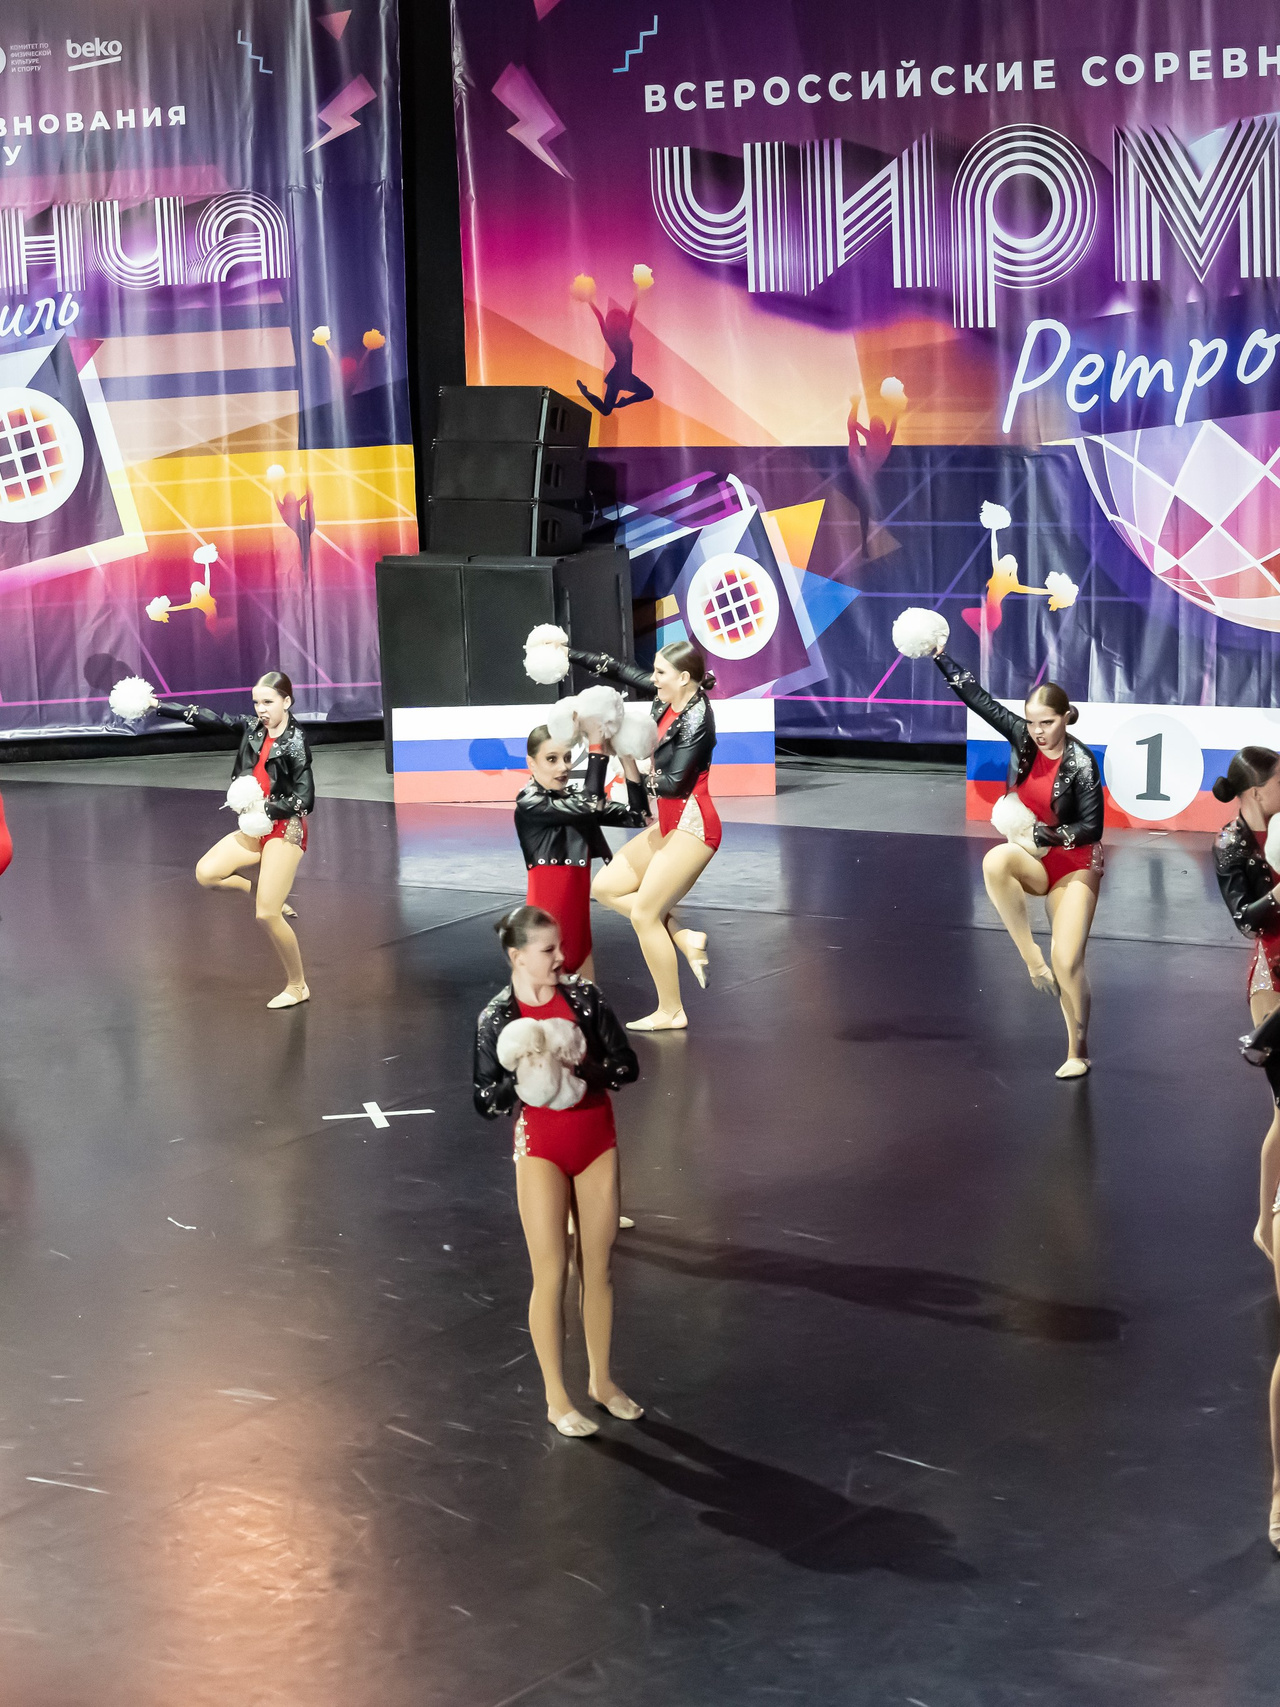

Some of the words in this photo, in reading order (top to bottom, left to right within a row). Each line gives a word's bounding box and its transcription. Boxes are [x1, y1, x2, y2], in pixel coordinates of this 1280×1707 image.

[10, 49, 52, 58] ФИЗИЧЕСКОЙ
[66, 37, 123, 58] beko
[10, 58, 40, 66] КУЛЬТУРЕ
[17, 65, 42, 73] СПОРТУ
[645, 58, 1057, 113] ВСЕРОССИЙСКИЕ
[1081, 44, 1280, 88] СОРЕВН
[1002, 318, 1280, 434] Ретро
[1135, 733, 1171, 801] 1
